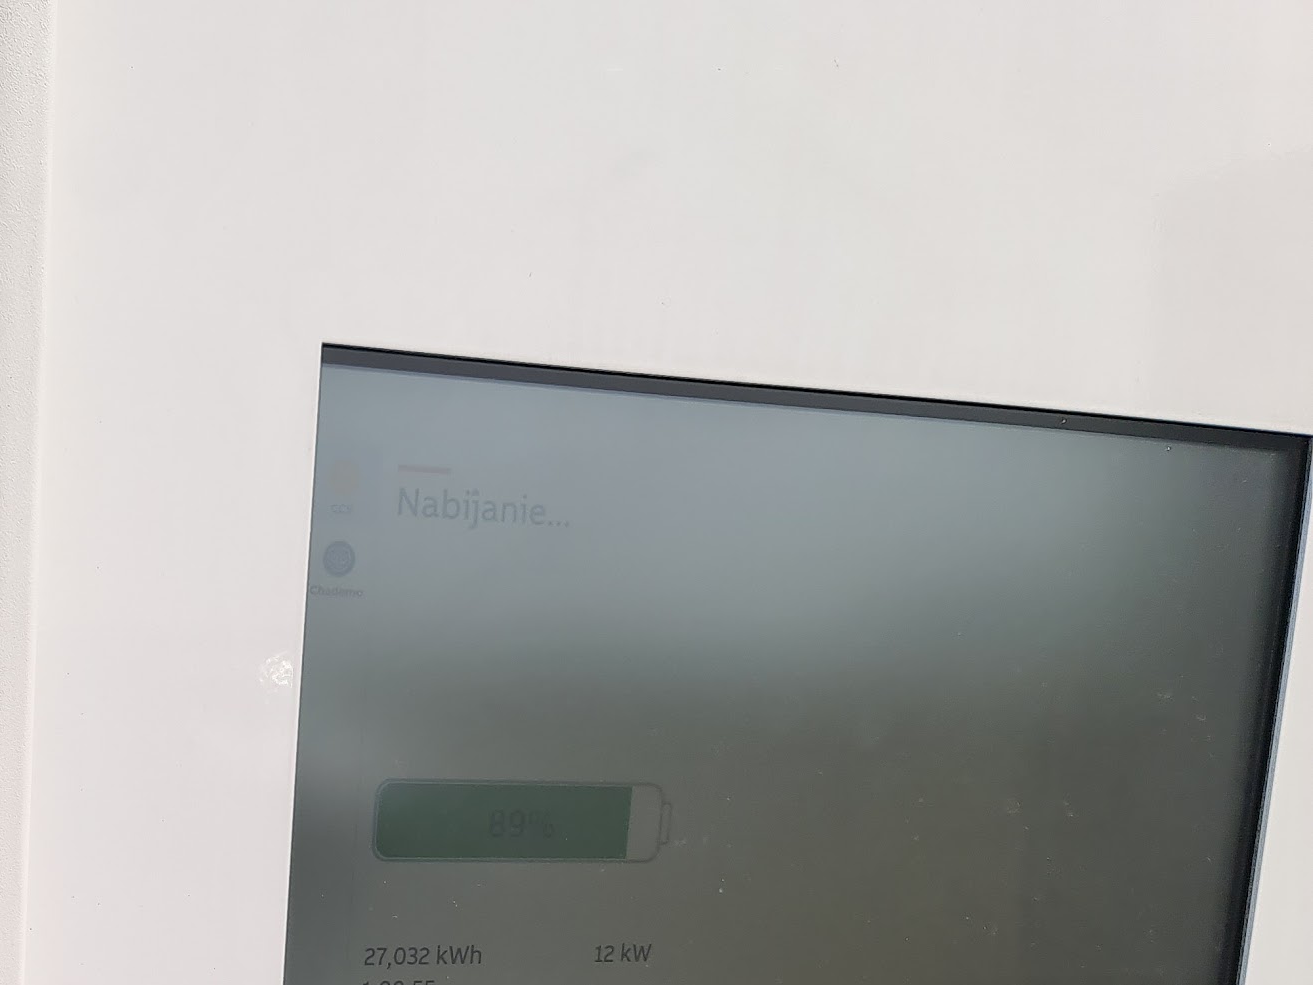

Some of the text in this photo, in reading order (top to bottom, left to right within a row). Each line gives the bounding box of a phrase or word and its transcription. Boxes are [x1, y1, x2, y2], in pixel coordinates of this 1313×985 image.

[397, 487, 570, 530] Nabijanie...
[490, 809, 555, 838] 89%
[363, 945, 482, 970] 27,032 kWh
[594, 943, 652, 963] 12 kW
